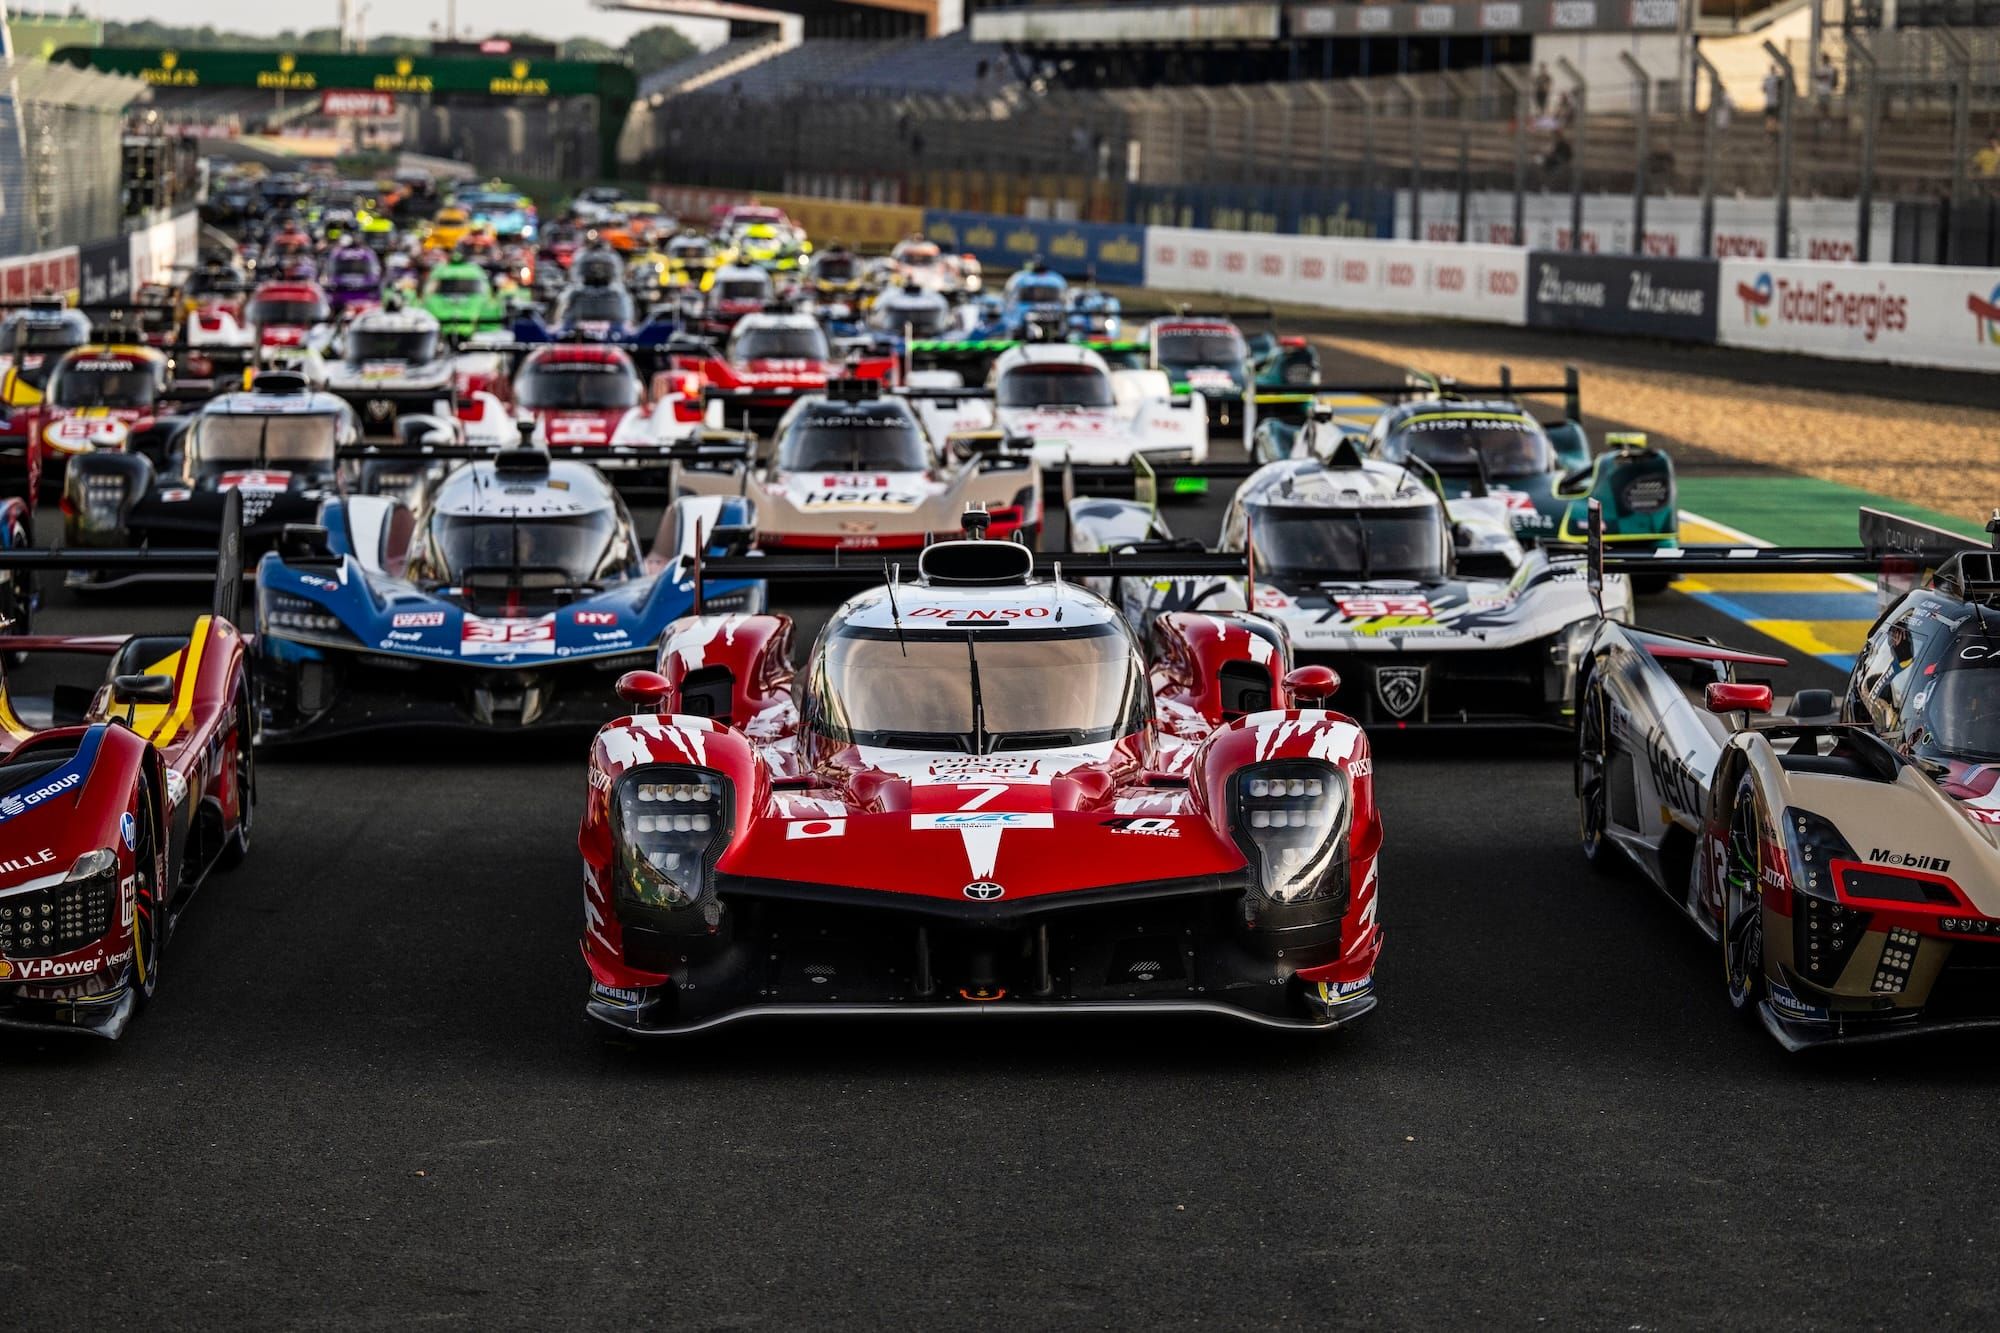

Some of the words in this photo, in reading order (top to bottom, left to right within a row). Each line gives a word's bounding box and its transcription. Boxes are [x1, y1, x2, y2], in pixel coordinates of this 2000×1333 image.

[257, 71, 316, 89] ROLEX
[373, 74, 433, 92] ROLEX
[489, 77, 549, 95] ROLEX
[1776, 279, 1907, 342] TotalEnergies
[804, 491, 919, 504] Hertz
[455, 504, 585, 514] ALPINE
[1885, 528, 1925, 558] CADILLAC
[907, 607, 1050, 620] DENSO
[1342, 601, 1431, 616] 93
[463, 619, 554, 643] 35
[1305, 628, 1489, 639] PEUGEOT
[23, 773, 81, 805] GROUP
[956, 784, 1010, 811] 7
[935, 813, 1029, 822] WEC
[1133, 829, 1182, 838] MANS
[0, 848, 57, 874] ILLE
[1869, 848, 1929, 869] Mobil
[1762, 865, 1786, 891] JOTA
[17, 957, 101, 979] V-Power
[596, 983, 639, 1002] MICHELIN
[1772, 990, 1816, 1013] MICHELIN
